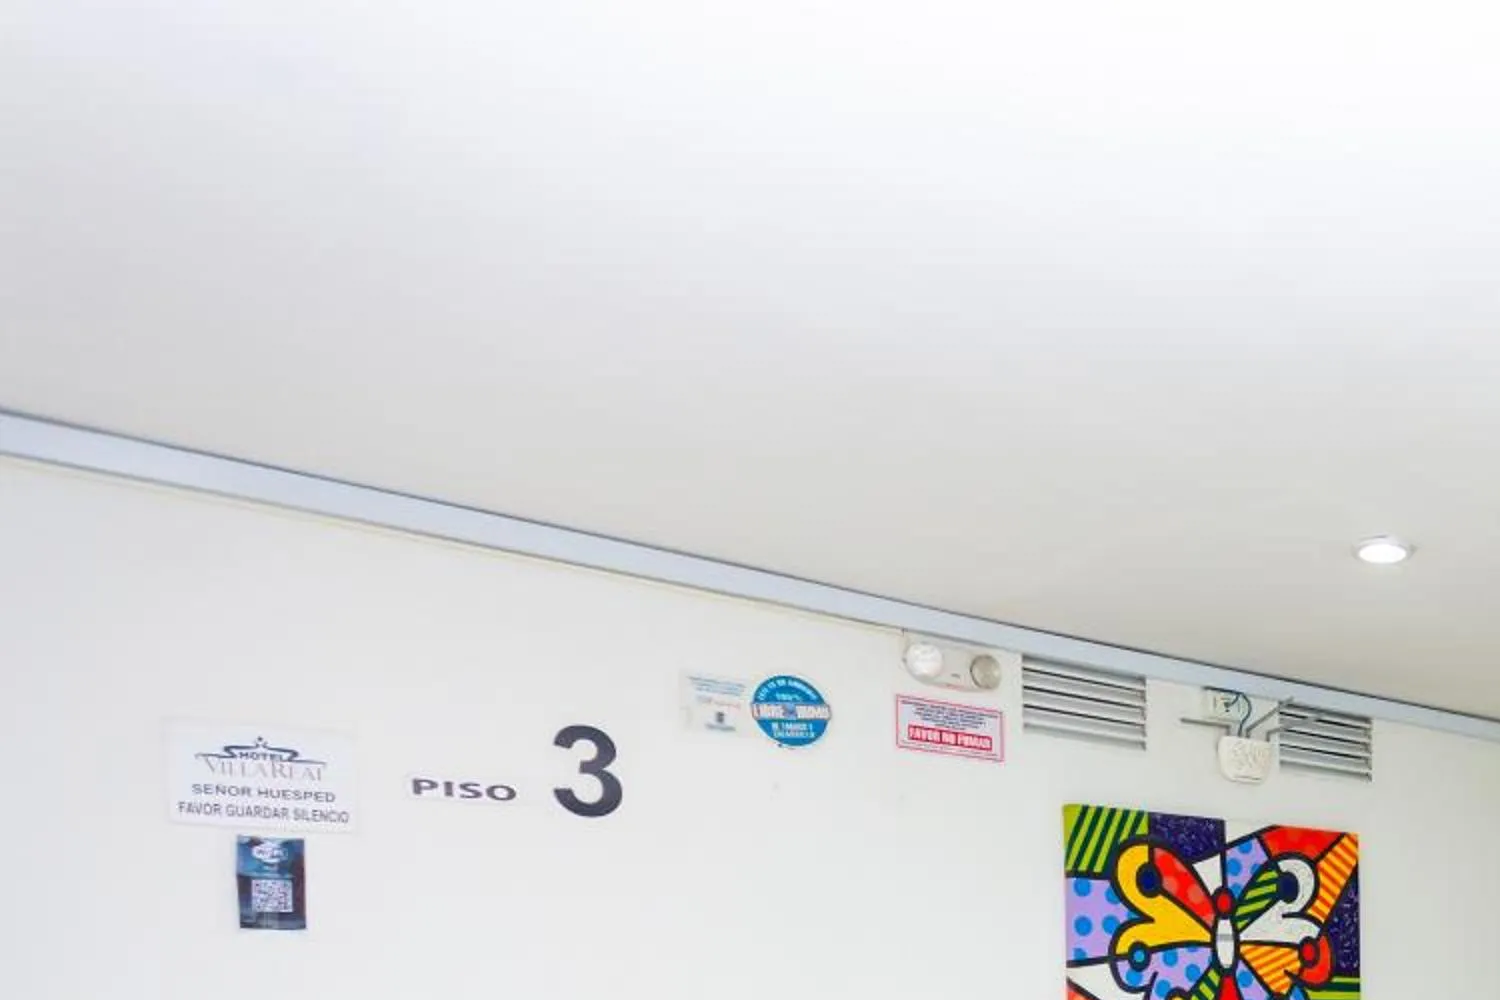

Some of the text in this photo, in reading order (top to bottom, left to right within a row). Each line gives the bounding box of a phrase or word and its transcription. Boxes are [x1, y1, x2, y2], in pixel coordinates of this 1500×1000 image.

[908, 726, 941, 743] FAVOR
[942, 731, 957, 745] NO
[957, 733, 992, 750] FUMAR
[240, 752, 284, 762] HOTEL
[411, 724, 623, 818] PISO 3
[257, 787, 336, 803] HUESPED
[178, 801, 350, 824] FAVOR GUARDAR SILENCIO
